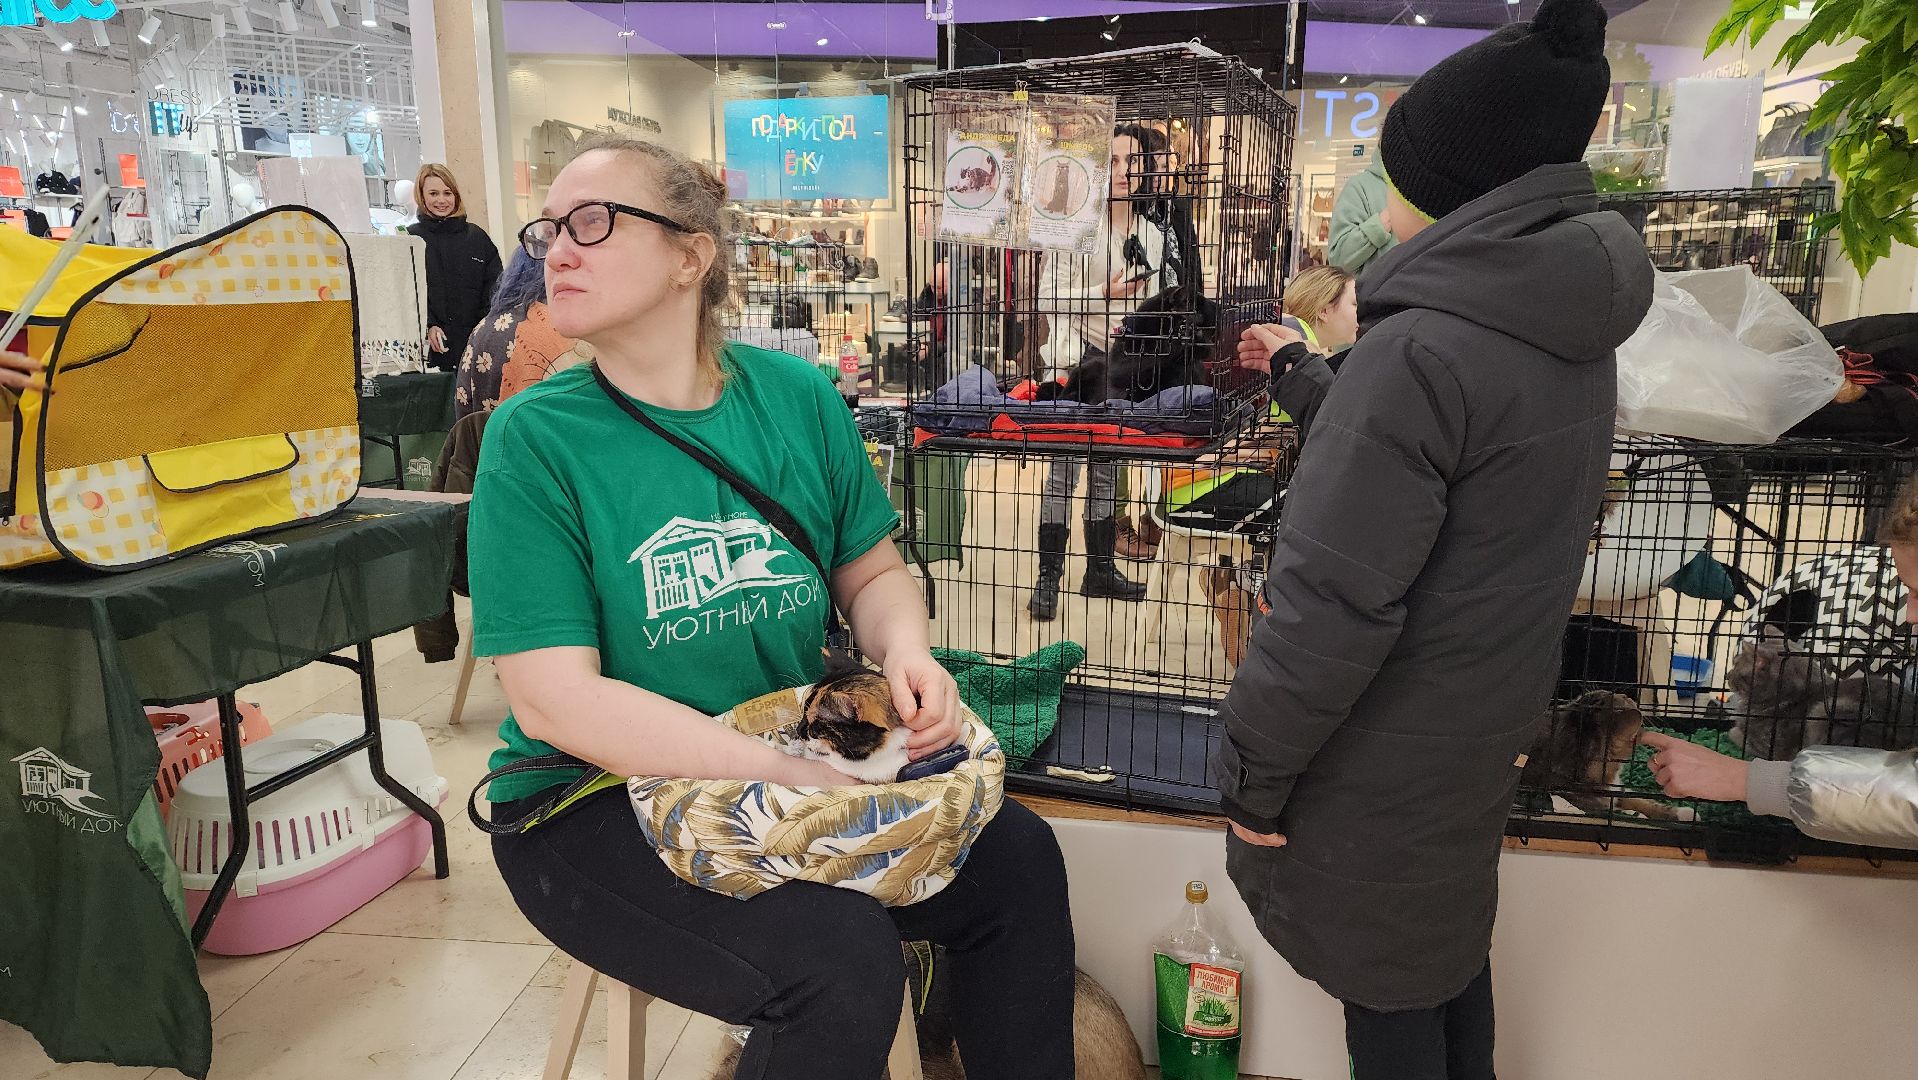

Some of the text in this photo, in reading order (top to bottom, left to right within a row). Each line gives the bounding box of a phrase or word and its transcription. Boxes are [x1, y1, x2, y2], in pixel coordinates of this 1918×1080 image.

[147, 88, 201, 105] DRESS
[821, 114, 857, 141] ПОД
[785, 148, 824, 177] ЁЛКУ
[1197, 970, 1234, 988] ЛЮБИМЫЙ
[1201, 980, 1228, 995] АРОМАТ
